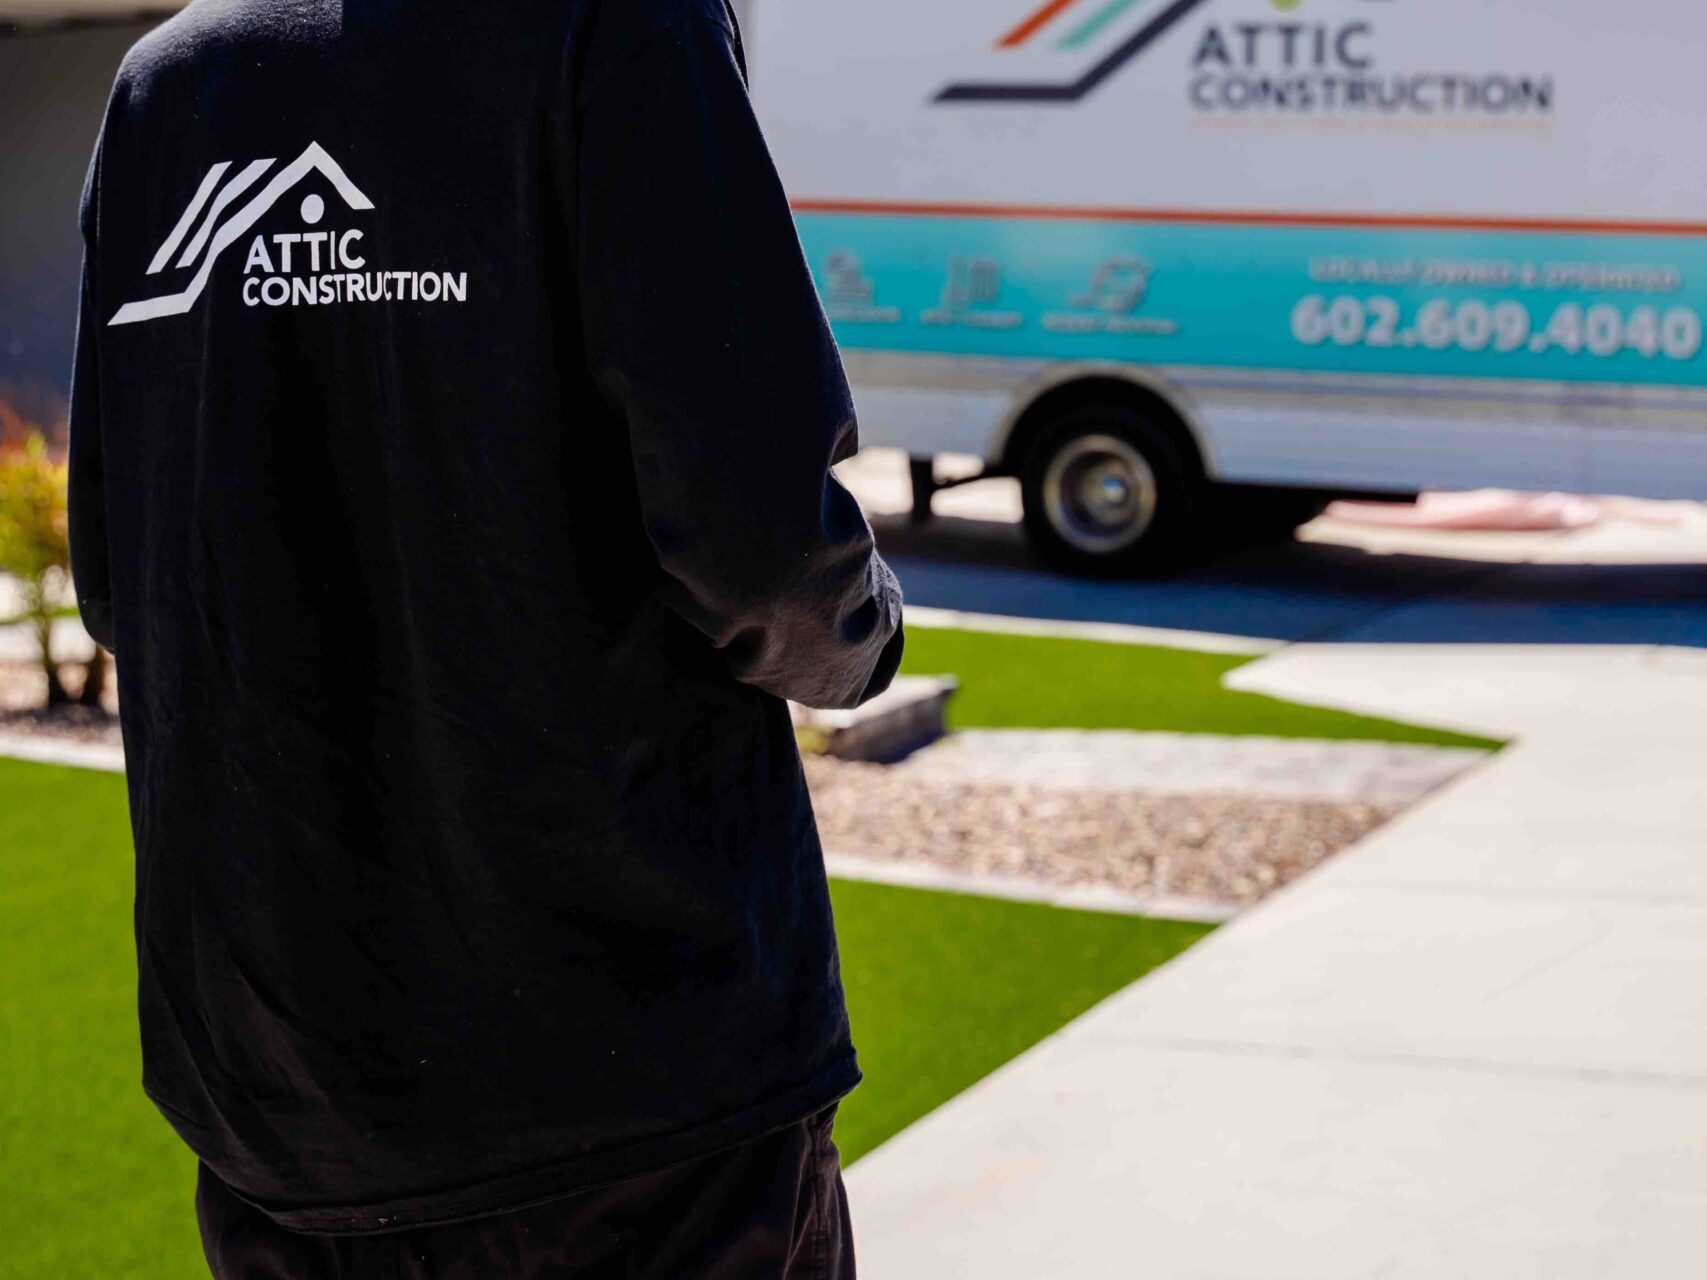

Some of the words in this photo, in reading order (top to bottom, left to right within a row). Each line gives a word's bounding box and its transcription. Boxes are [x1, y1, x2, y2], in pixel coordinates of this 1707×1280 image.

[1194, 23, 1371, 67] ATTIC
[1190, 73, 1552, 114] CONSTRUCTION
[243, 229, 365, 274] ATTIC
[243, 271, 467, 306] CONSTRUCTION
[1291, 294, 1702, 359] 602.609.4040
